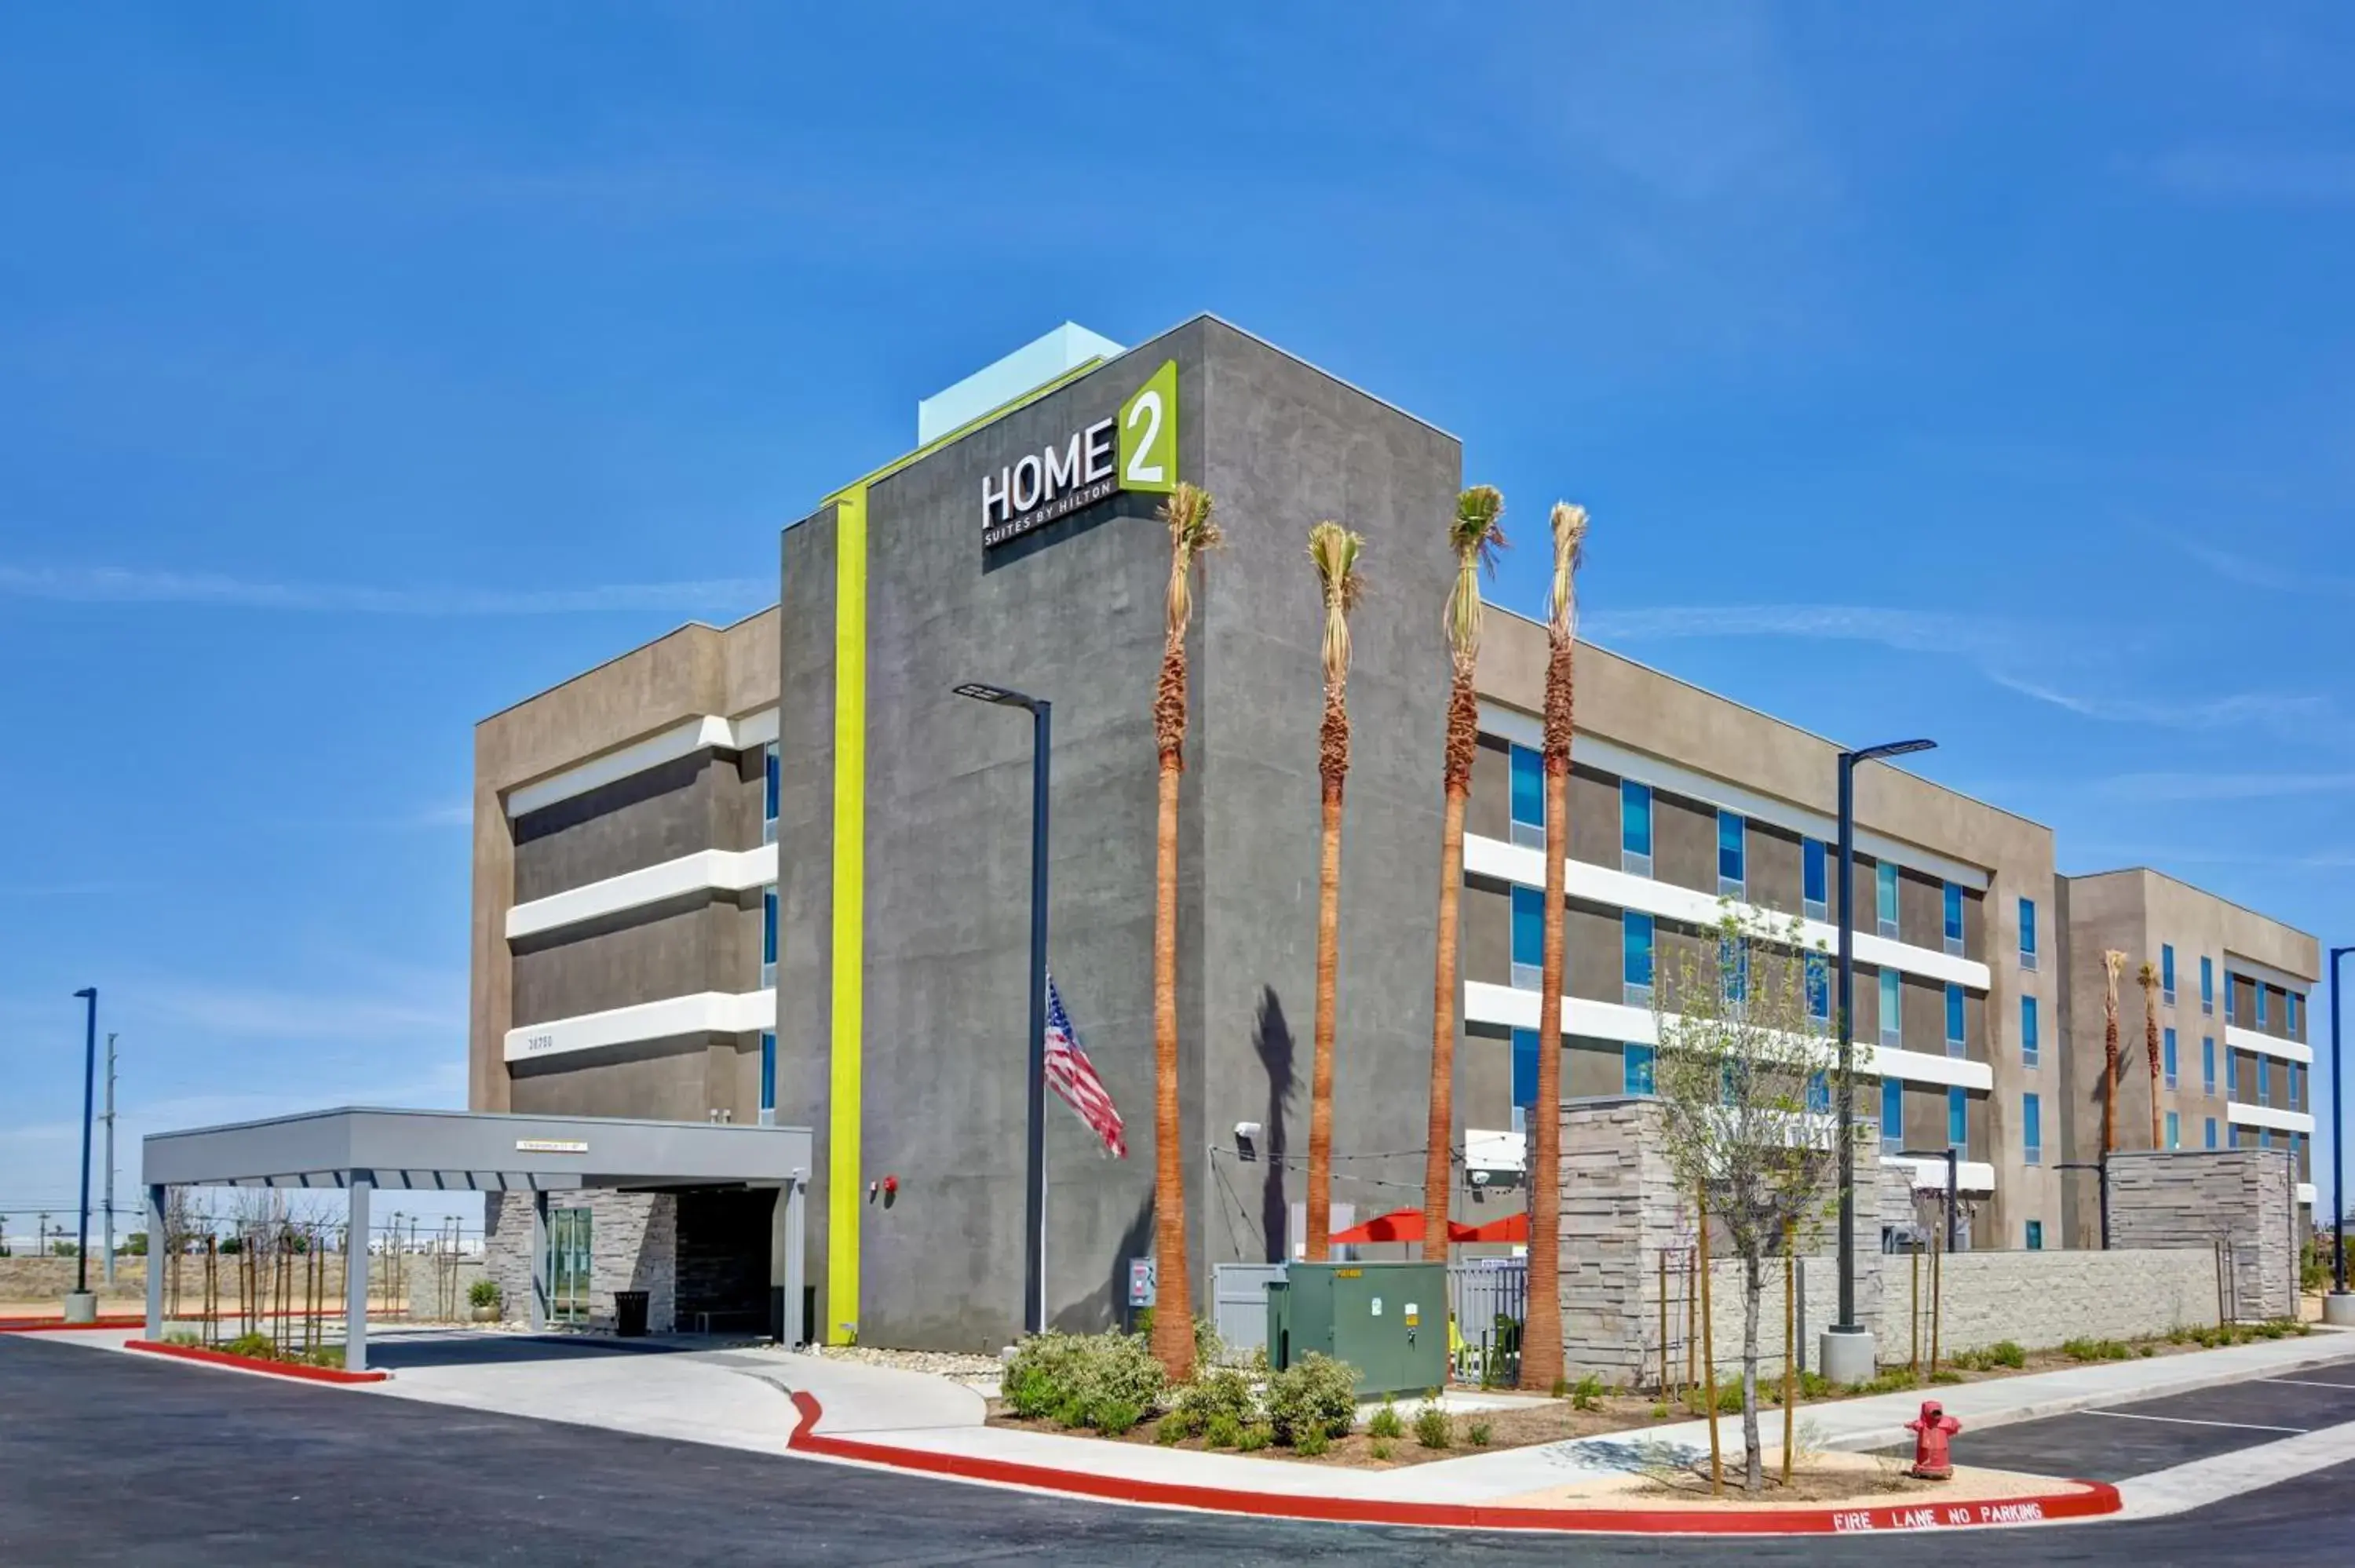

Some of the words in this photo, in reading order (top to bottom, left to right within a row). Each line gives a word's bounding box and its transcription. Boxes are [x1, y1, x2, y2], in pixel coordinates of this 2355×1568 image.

[982, 417, 1113, 530] HOME
[1126, 390, 1163, 483] 2
[984, 518, 1031, 545] SUITES
[1036, 506, 1053, 523] BY
[1059, 480, 1111, 512] HILTON
[1833, 1511, 1872, 1533] FIRE
[1891, 1508, 1936, 1529] LANE
[1947, 1507, 1971, 1524] NO
[1979, 1503, 2043, 1523] PARKING
